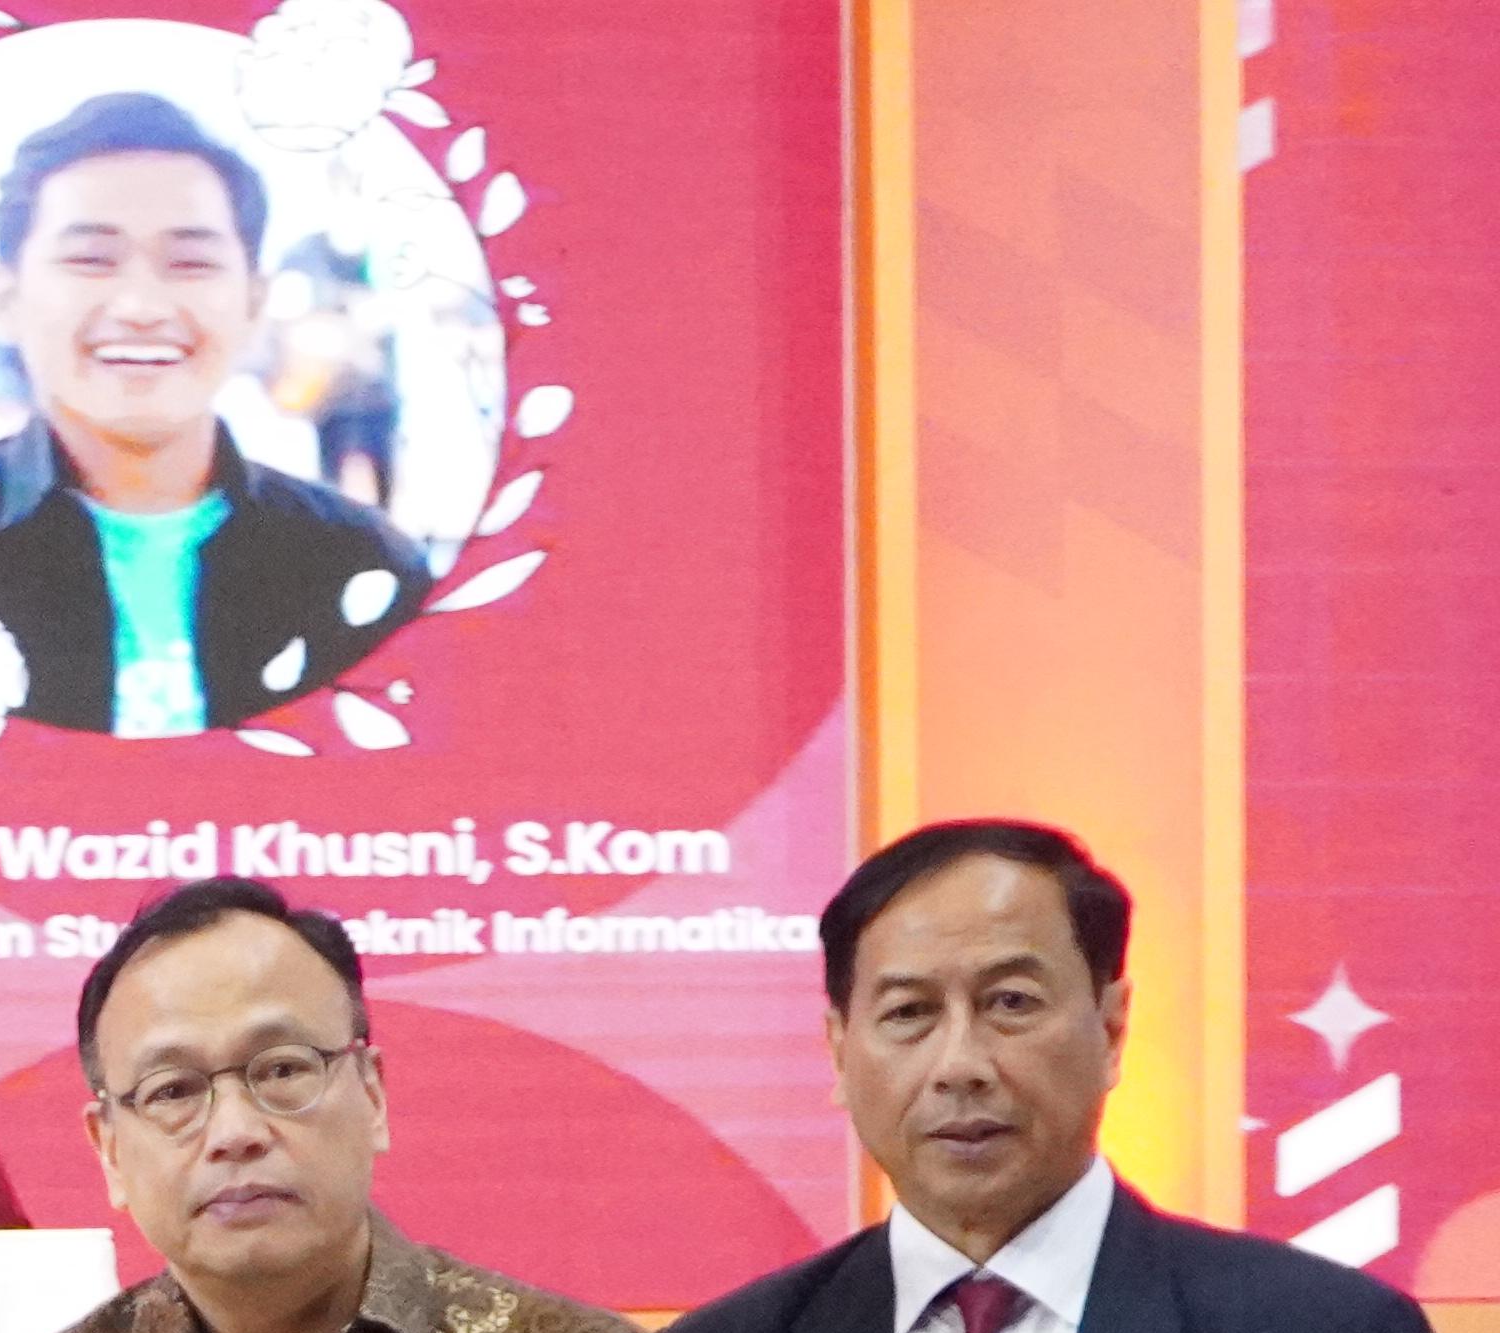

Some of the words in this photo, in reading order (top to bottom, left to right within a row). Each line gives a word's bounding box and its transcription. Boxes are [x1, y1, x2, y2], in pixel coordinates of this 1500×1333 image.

[232, 817, 493, 886] Khusni,
[505, 820, 731, 876] S.Kom
[346, 907, 484, 955] eknik
[493, 906, 820, 954] Informatika
